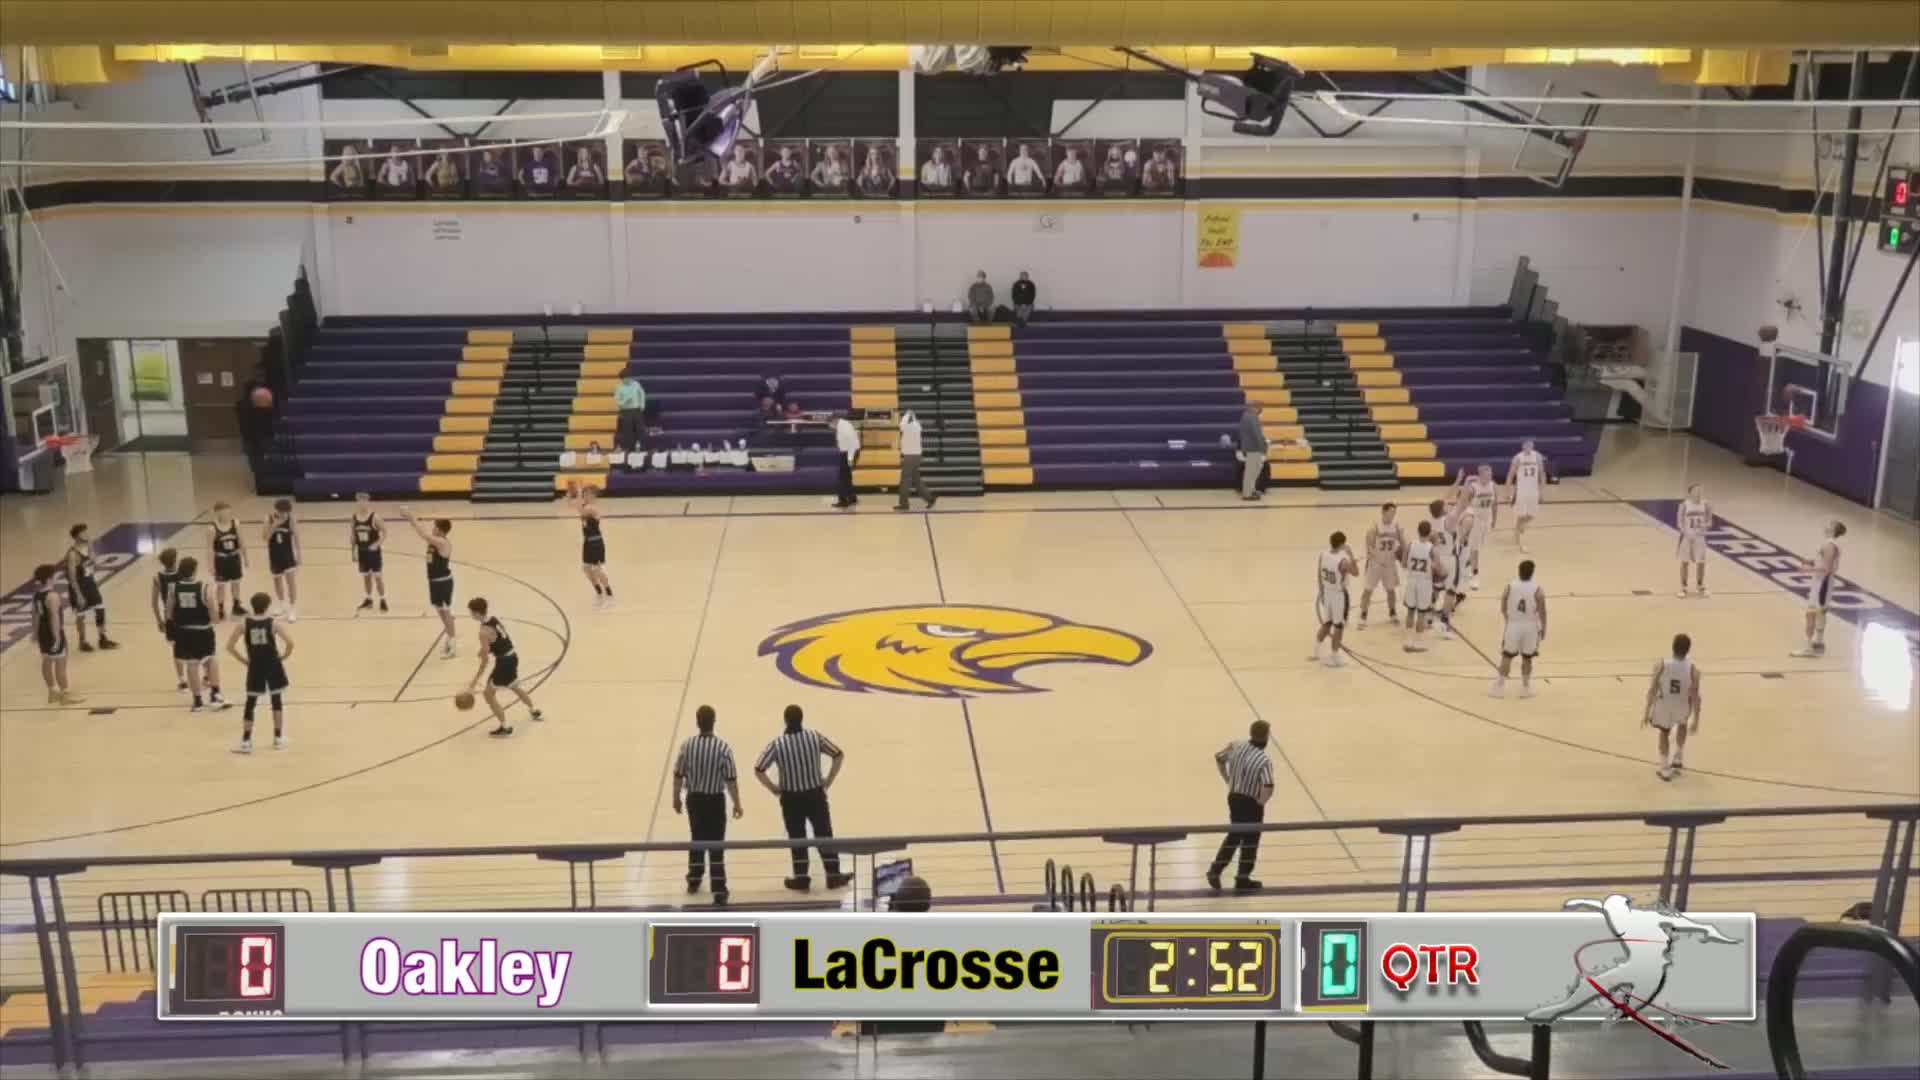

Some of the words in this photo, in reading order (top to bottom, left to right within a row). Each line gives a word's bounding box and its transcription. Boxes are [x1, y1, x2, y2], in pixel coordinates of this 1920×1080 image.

[1895, 182, 1907, 205] 0
[1888, 226, 1899, 248] 0
[1410, 558, 1428, 573] 22
[1517, 598, 1527, 613] 4
[1669, 679, 1681, 694] 5
